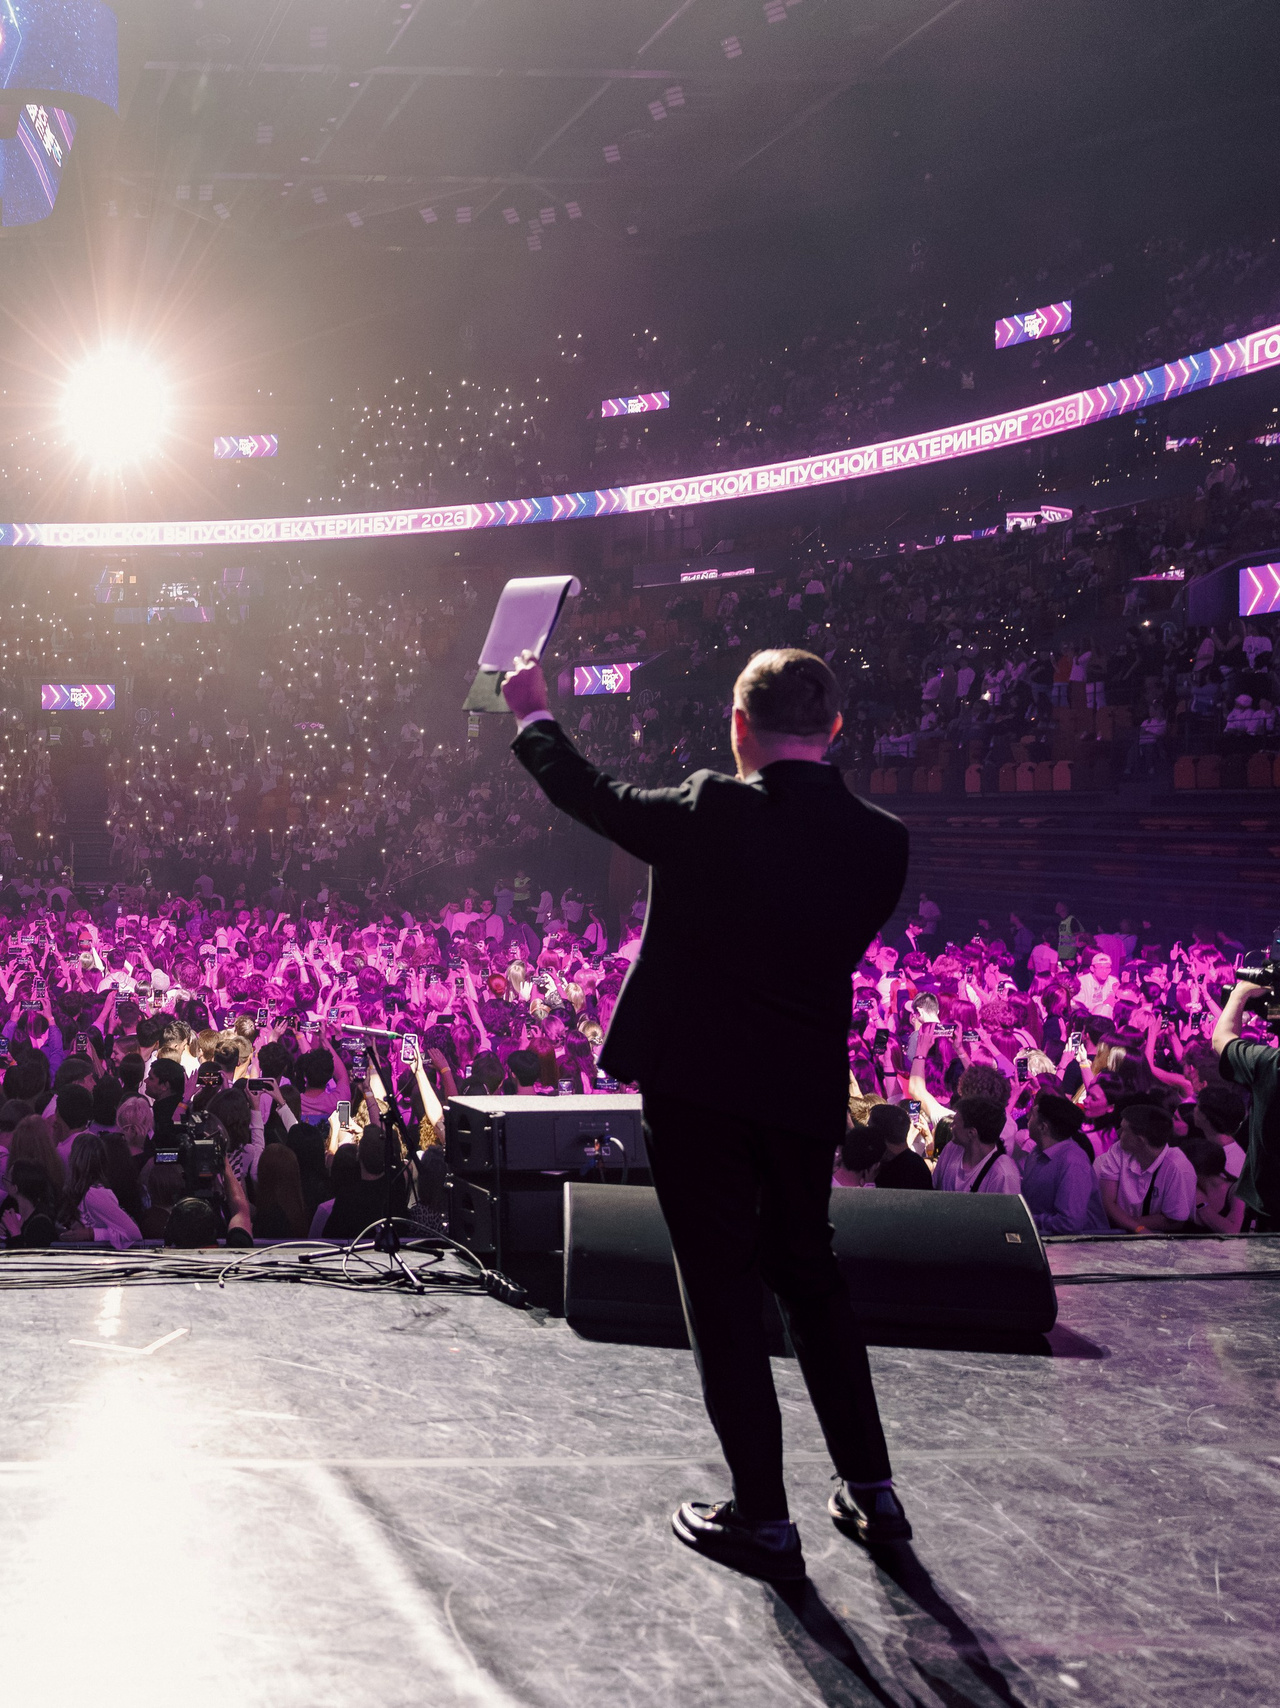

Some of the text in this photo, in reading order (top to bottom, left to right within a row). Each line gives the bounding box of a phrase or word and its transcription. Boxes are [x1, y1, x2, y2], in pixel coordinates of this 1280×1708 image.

[635, 402, 1076, 507] ГОРОДСКОЙ ВЫПУСКНОЙ ЕКАТЕРИНБУРГ 2026
[52, 510, 465, 544] ГОРОДСКОЙ ВЫПУСКНОЙ ЕКАТЕРИНБУРГ 2026
